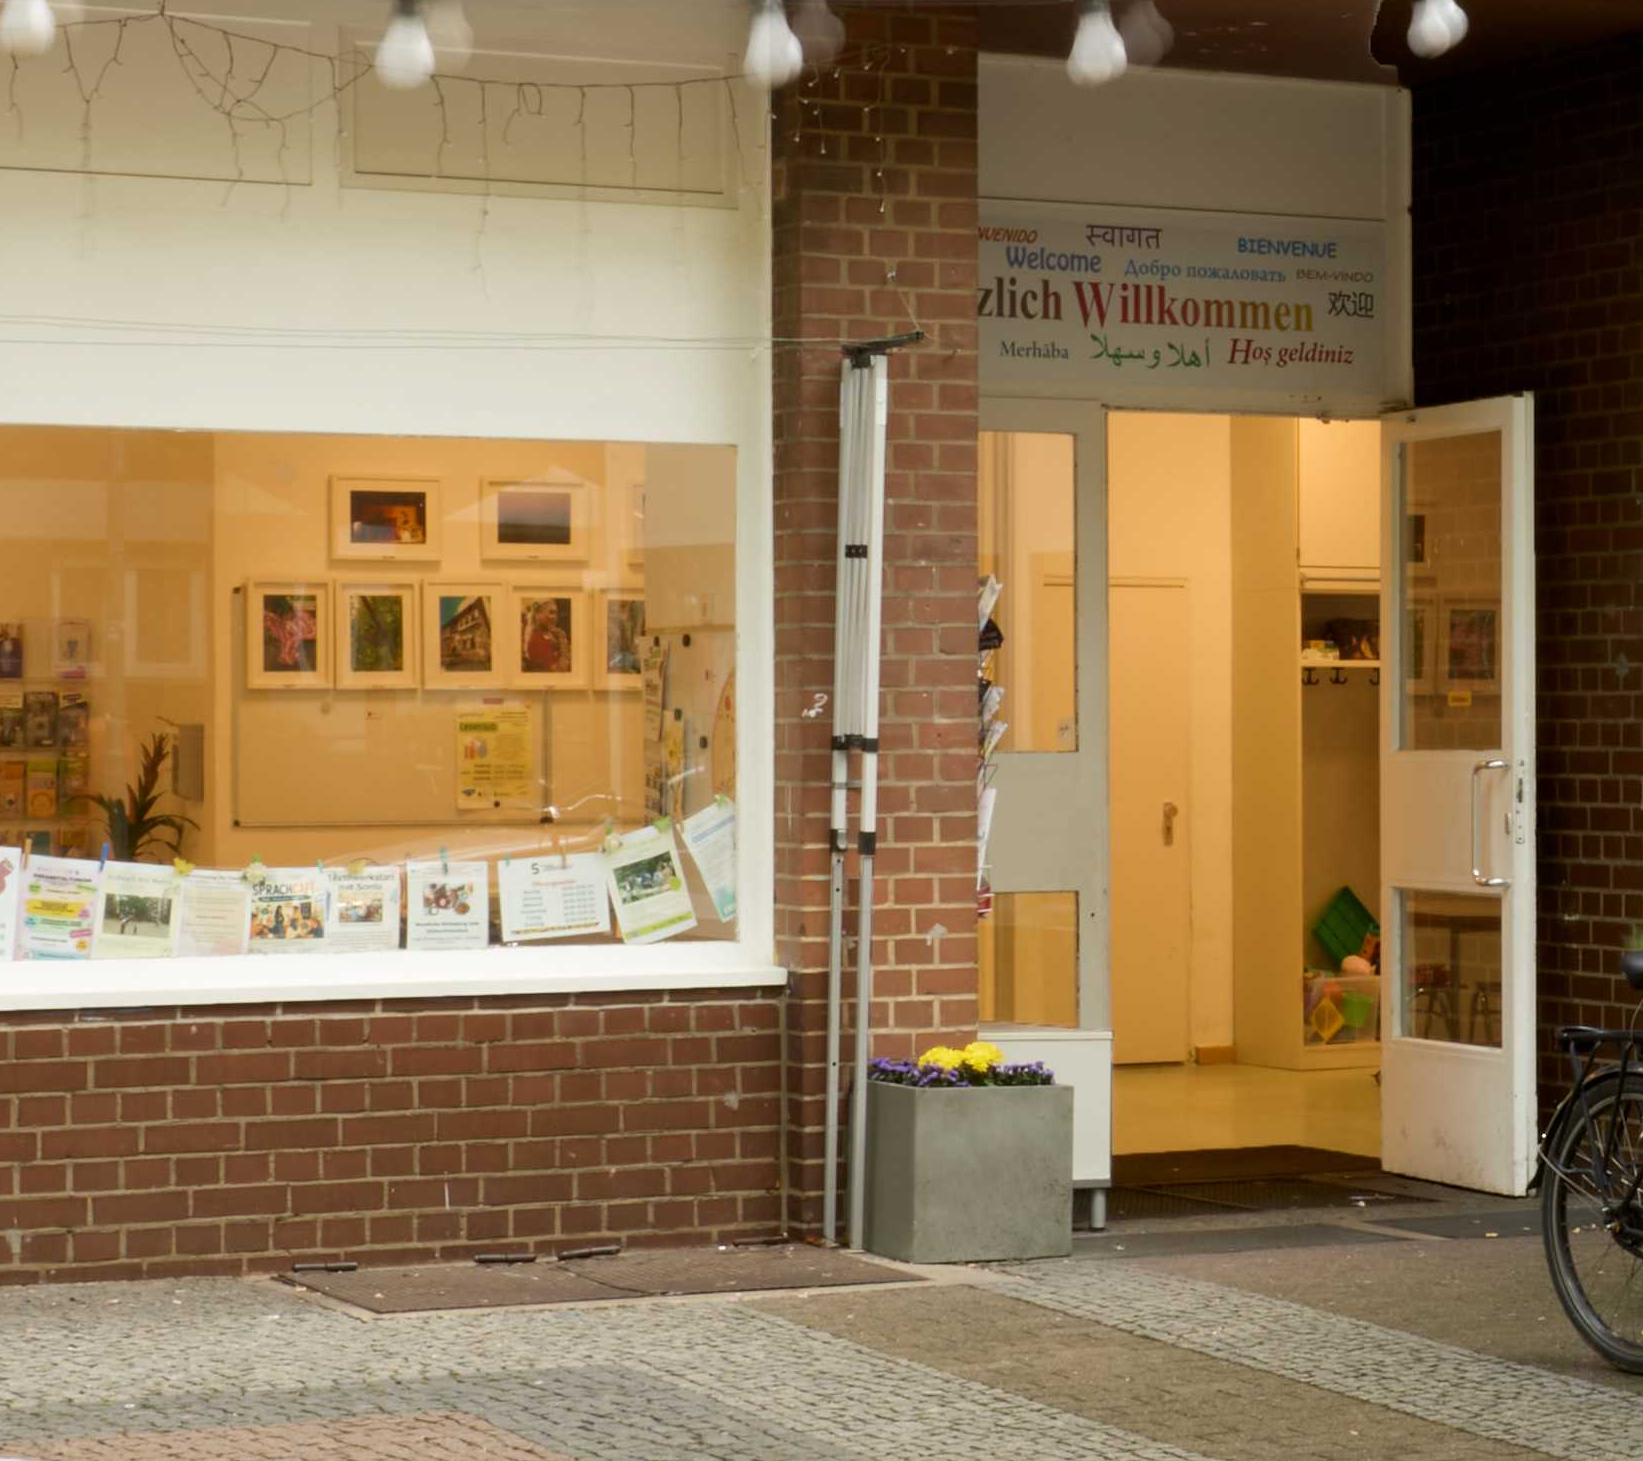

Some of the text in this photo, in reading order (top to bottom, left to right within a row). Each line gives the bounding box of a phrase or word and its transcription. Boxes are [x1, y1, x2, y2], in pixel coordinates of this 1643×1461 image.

[1085, 224, 1163, 250] स्वागत
[1237, 237, 1338, 259] BIENVENUE
[1005, 246, 1102, 273] Welcome
[1124, 259, 1287, 284] Добро пожаловать
[1295, 268, 1374, 284] BEM-VINDO
[1072, 280, 1315, 332] Willkommen
[1327, 291, 1375, 319] 欢迎
[1227, 338, 1355, 368] Hoş geldiniz
